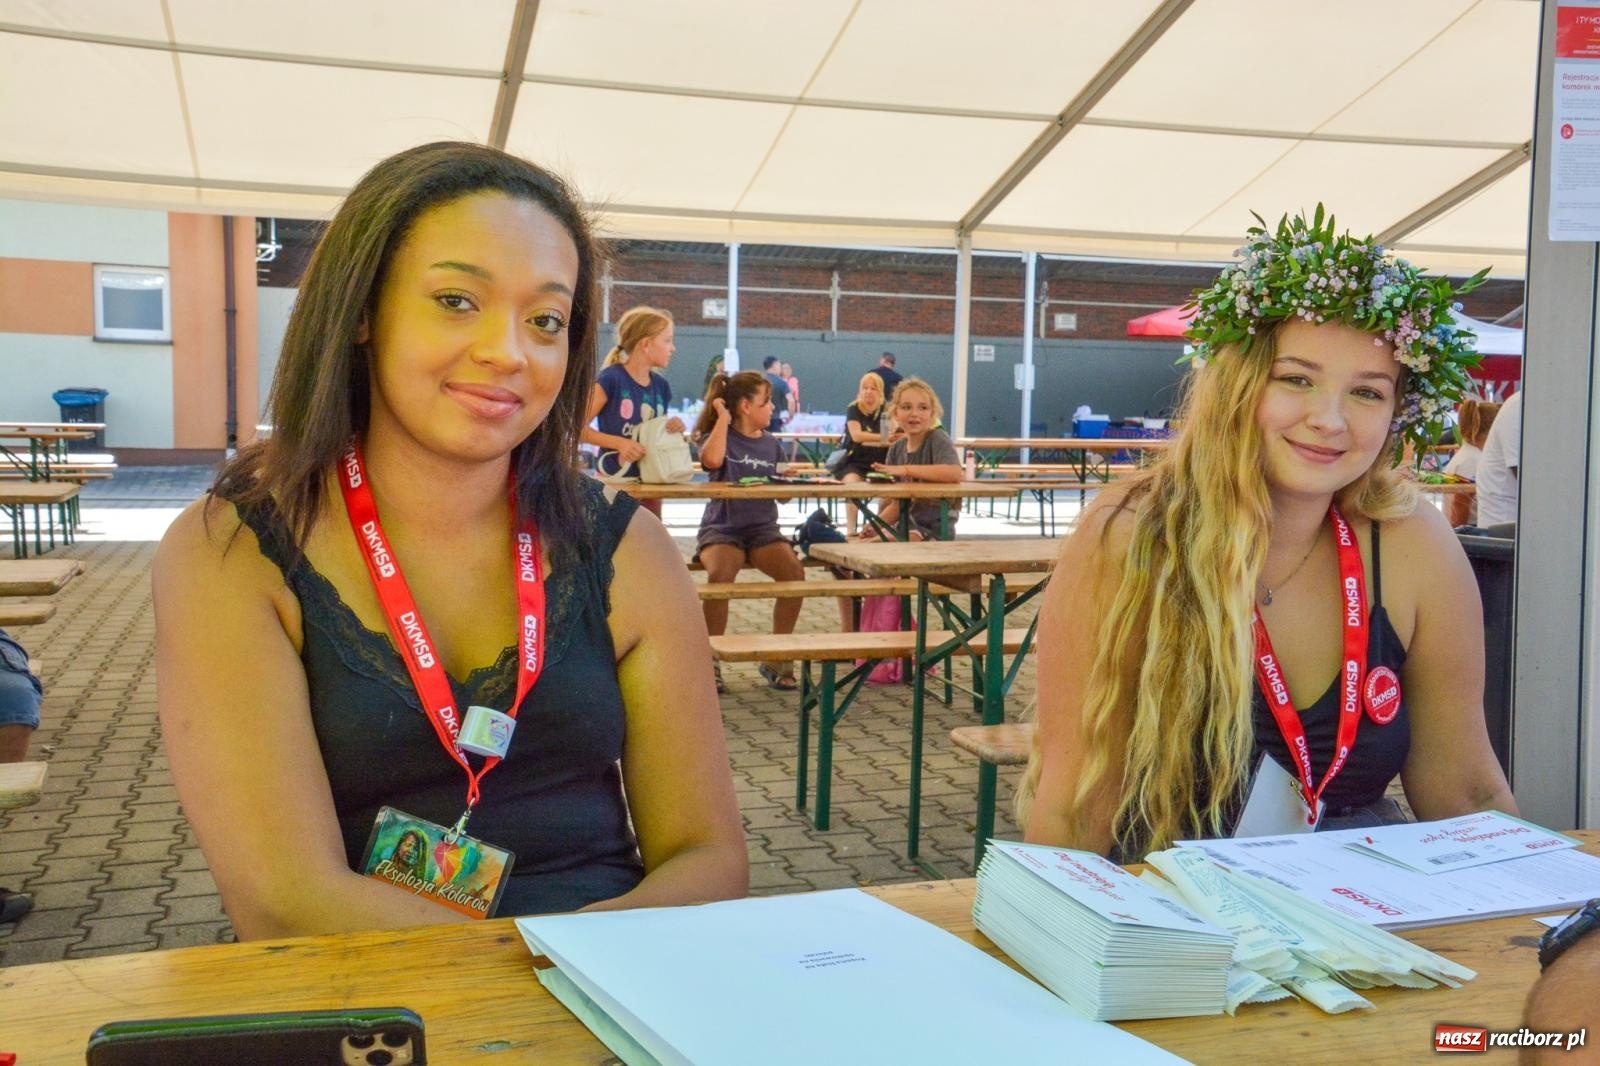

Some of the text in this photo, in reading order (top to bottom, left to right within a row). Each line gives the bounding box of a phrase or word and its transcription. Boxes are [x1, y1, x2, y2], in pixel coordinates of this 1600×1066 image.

[362, 521, 391, 566] DKMS
[518, 543, 535, 582] DKMS
[1347, 587, 1360, 627] DKMS
[400, 611, 430, 655] DKMS
[524, 628, 537, 673] DKMS
[1260, 655, 1285, 695] DKMS
[1346, 671, 1358, 713] DKMS
[1372, 687, 1394, 707] DKMS
[375, 859, 435, 895] Eksplozja
[1345, 893, 1403, 916] DKMS
